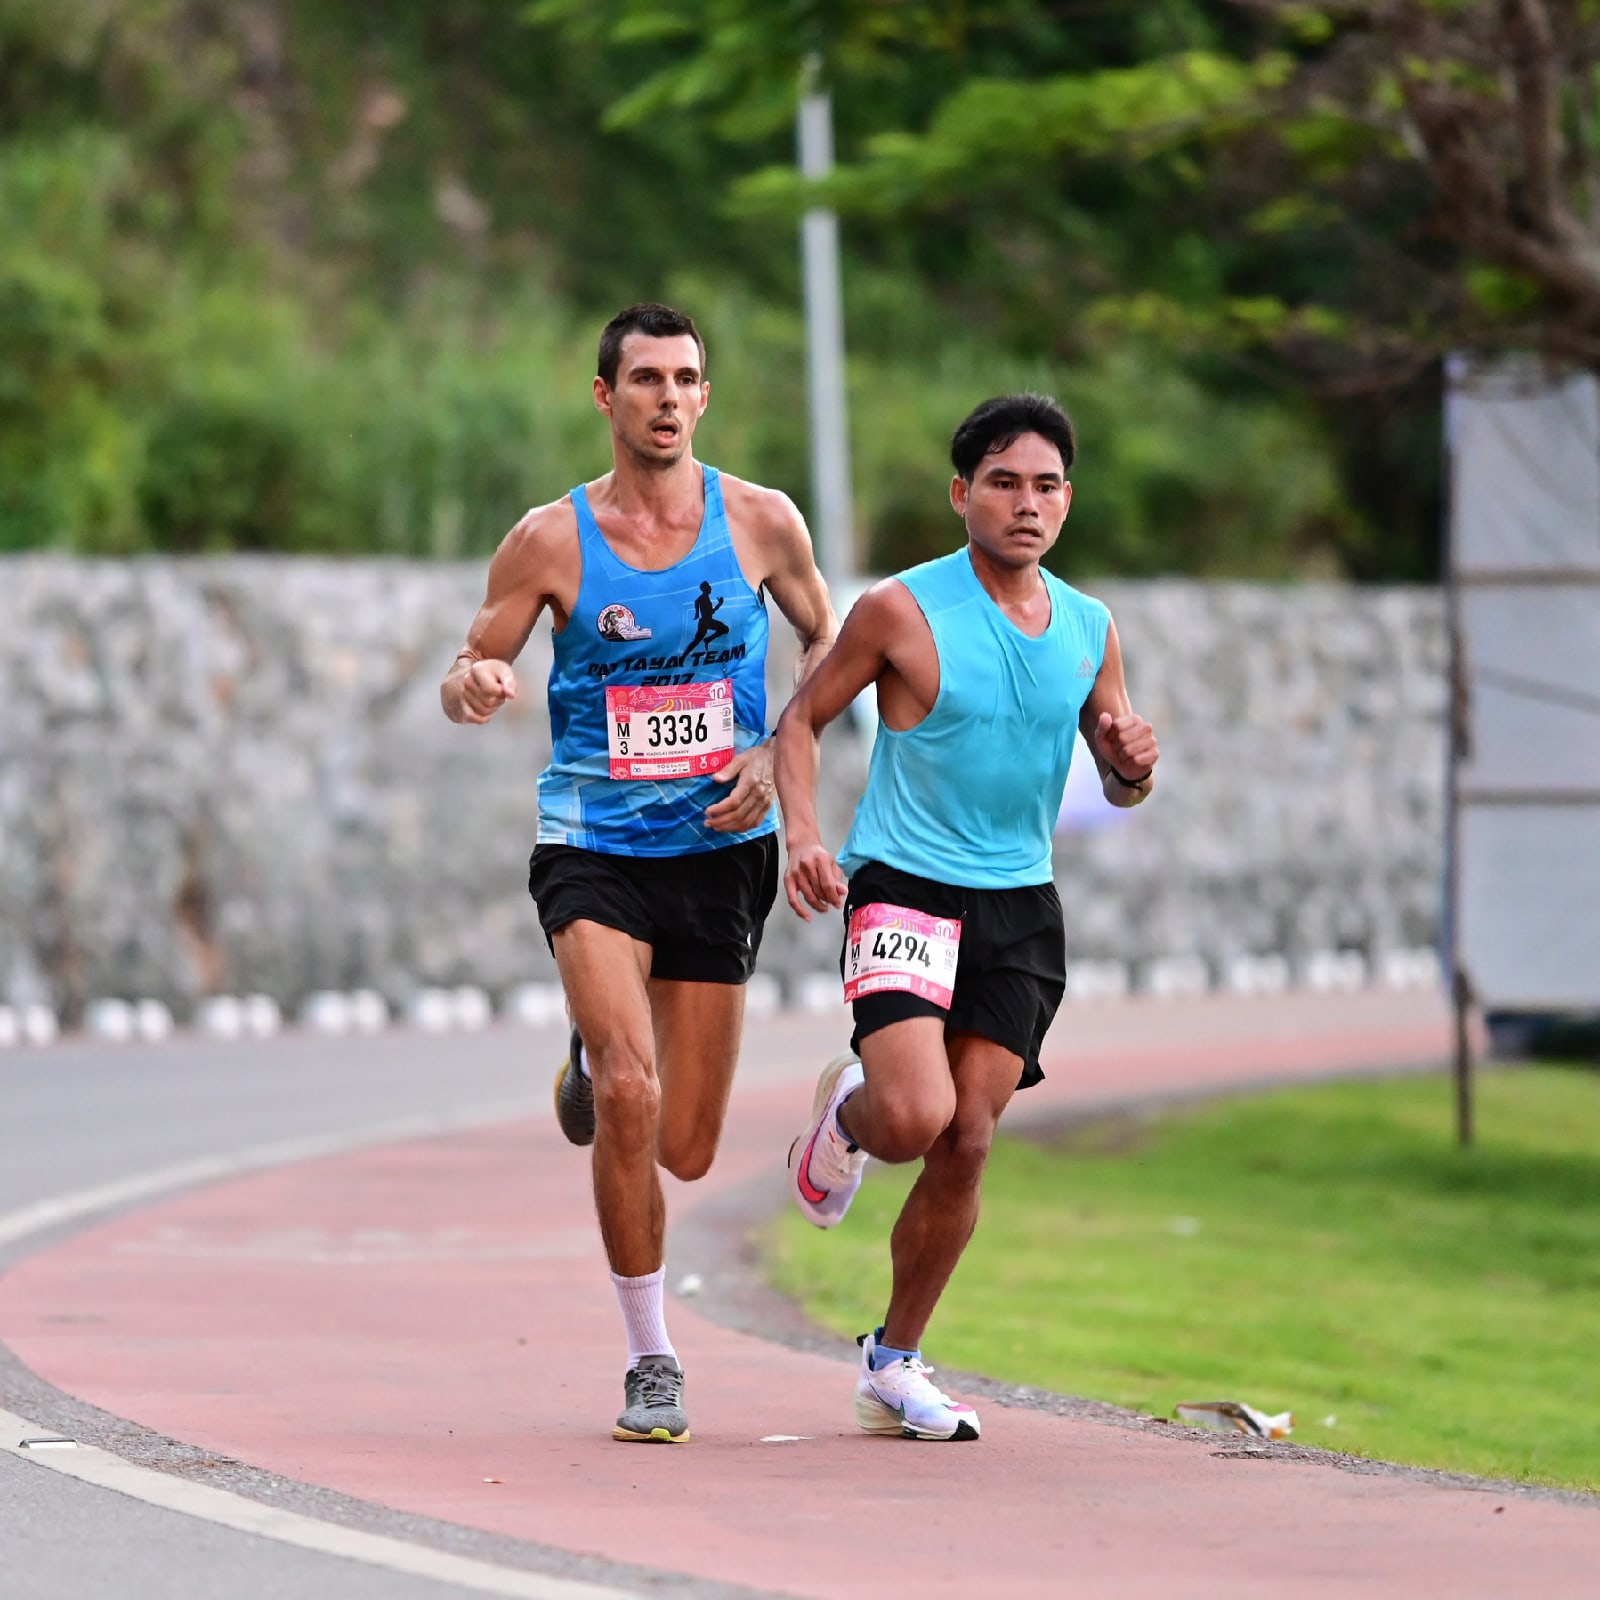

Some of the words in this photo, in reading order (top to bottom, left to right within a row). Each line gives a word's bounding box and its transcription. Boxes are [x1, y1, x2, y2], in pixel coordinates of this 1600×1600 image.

[691, 643, 746, 666] TEAM
[641, 672, 695, 687] 2017
[710, 686, 725, 700] 10
[616, 722, 631, 738] M
[647, 712, 708, 748] 3336
[620, 741, 629, 756] 3
[851, 945, 860, 959] M
[872, 932, 931, 968] 4294
[852, 962, 858, 976] 2
